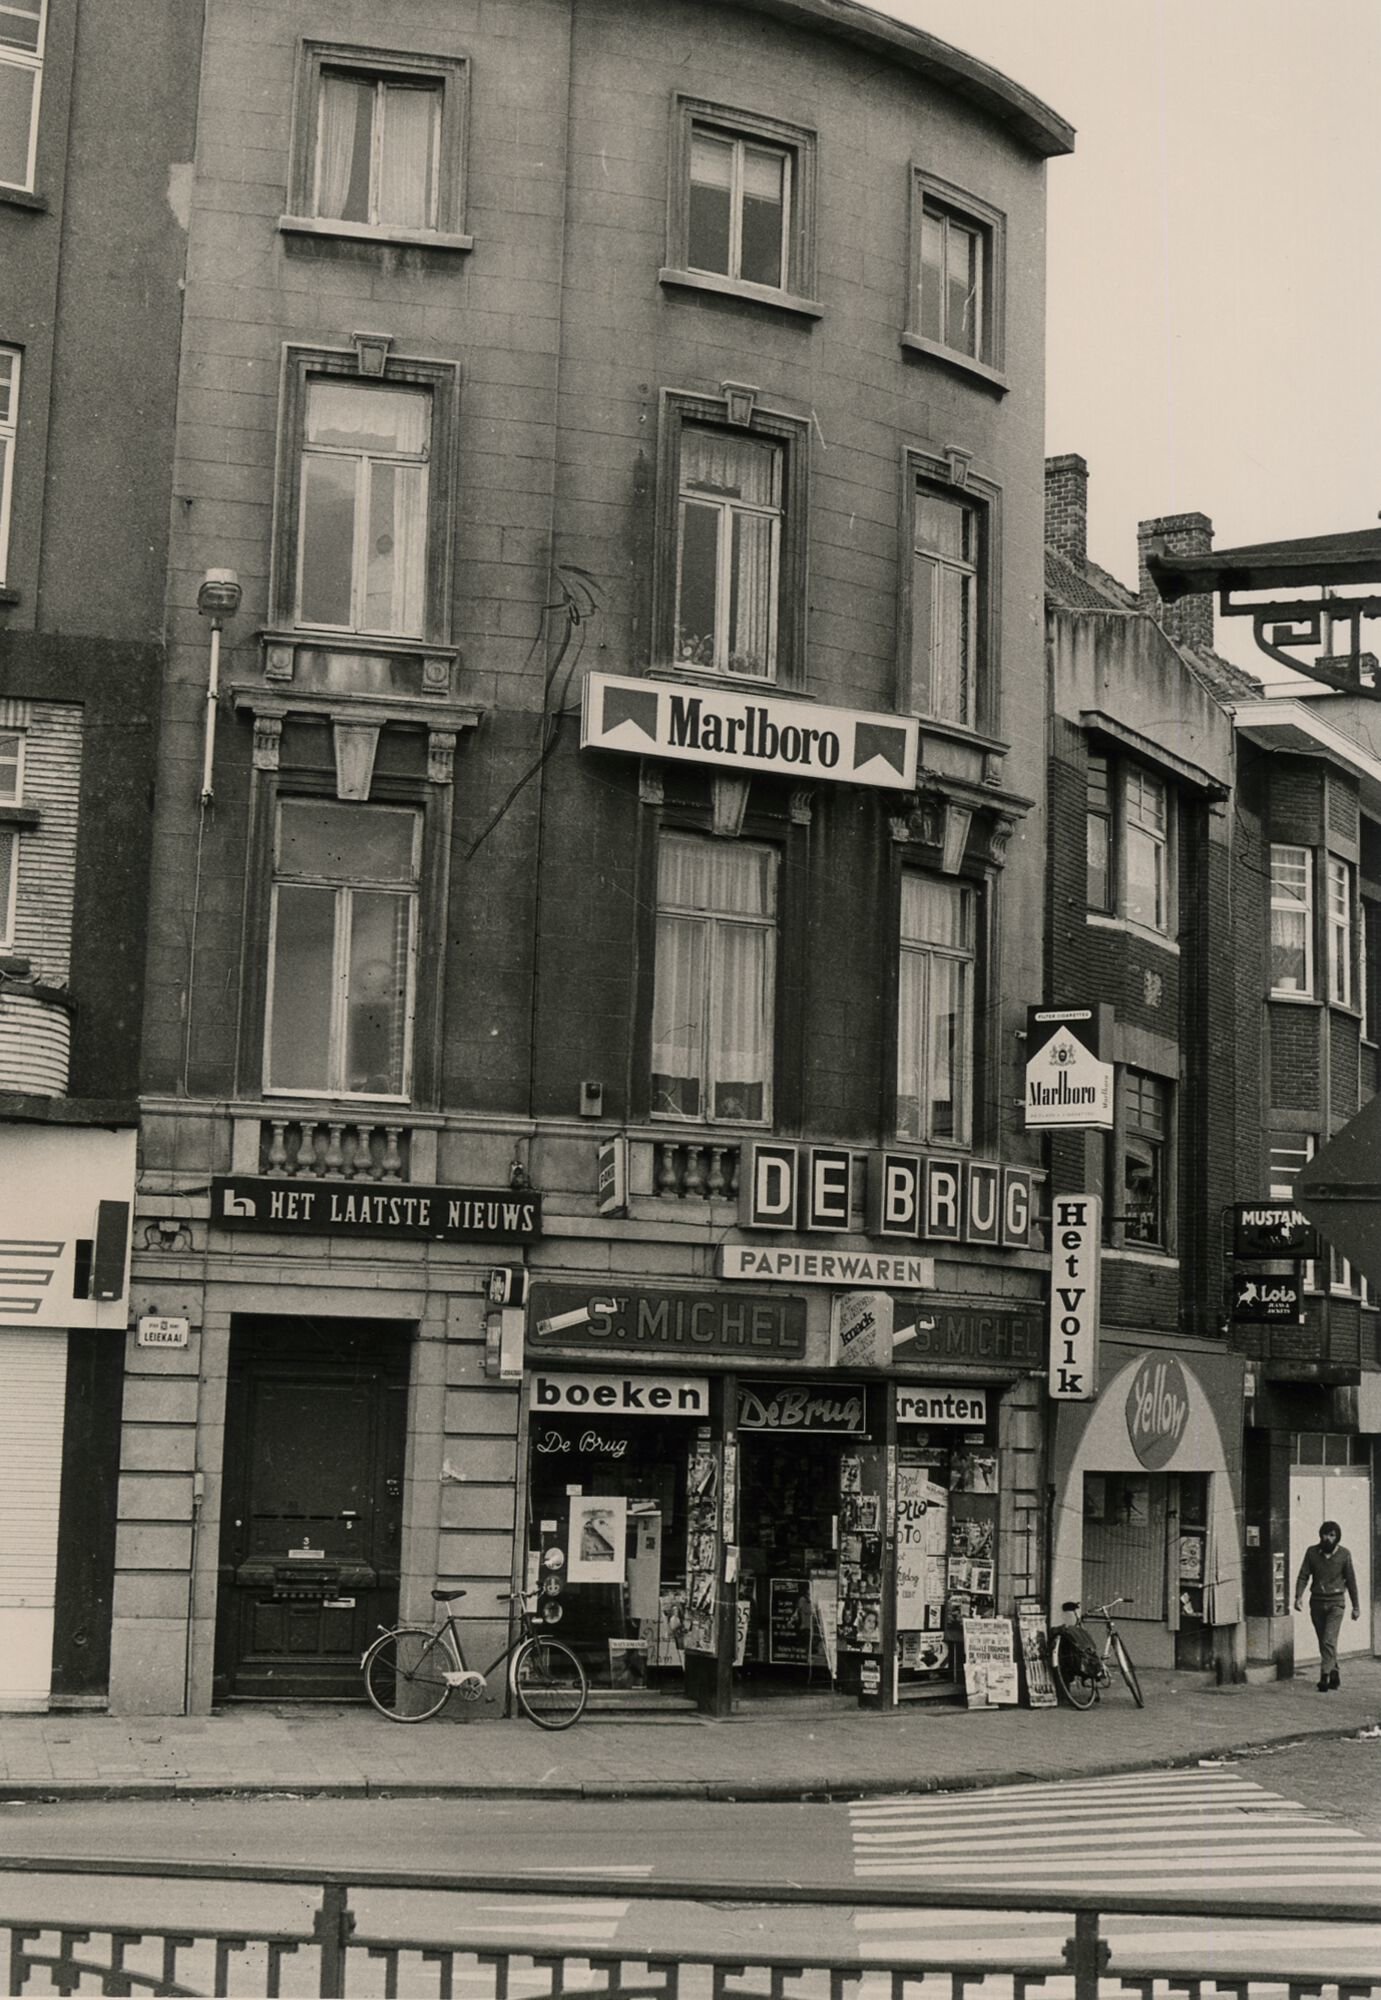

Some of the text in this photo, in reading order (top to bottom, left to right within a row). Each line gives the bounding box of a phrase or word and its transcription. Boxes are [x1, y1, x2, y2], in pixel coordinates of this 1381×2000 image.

[667, 695, 839, 768] Marlboro
[1029, 1071, 1095, 1106] Marlboro
[270, 1190, 314, 1221] HET
[330, 1193, 432, 1227] LAATSTE
[447, 1200, 535, 1233] NIEUWS
[756, 1156, 1029, 1235] DE BRUG
[740, 1250, 922, 1283] PAPIERWAREN
[1056, 1203, 1087, 1393] Het Volk
[1261, 1284, 1296, 1302] Lois
[144, 1332, 182, 1343] LEIEKAAI
[637, 1299, 800, 1347] MICHEL
[840, 1312, 876, 1347] knack
[946, 1316, 1038, 1358] MICHEL
[537, 1378, 700, 1409] boeken
[1133, 1363, 1186, 1439] Yellow
[537, 1431, 628, 1458] De Brug
[303, 1536, 310, 1545] 3
[346, 1521, 352, 1529] 5
